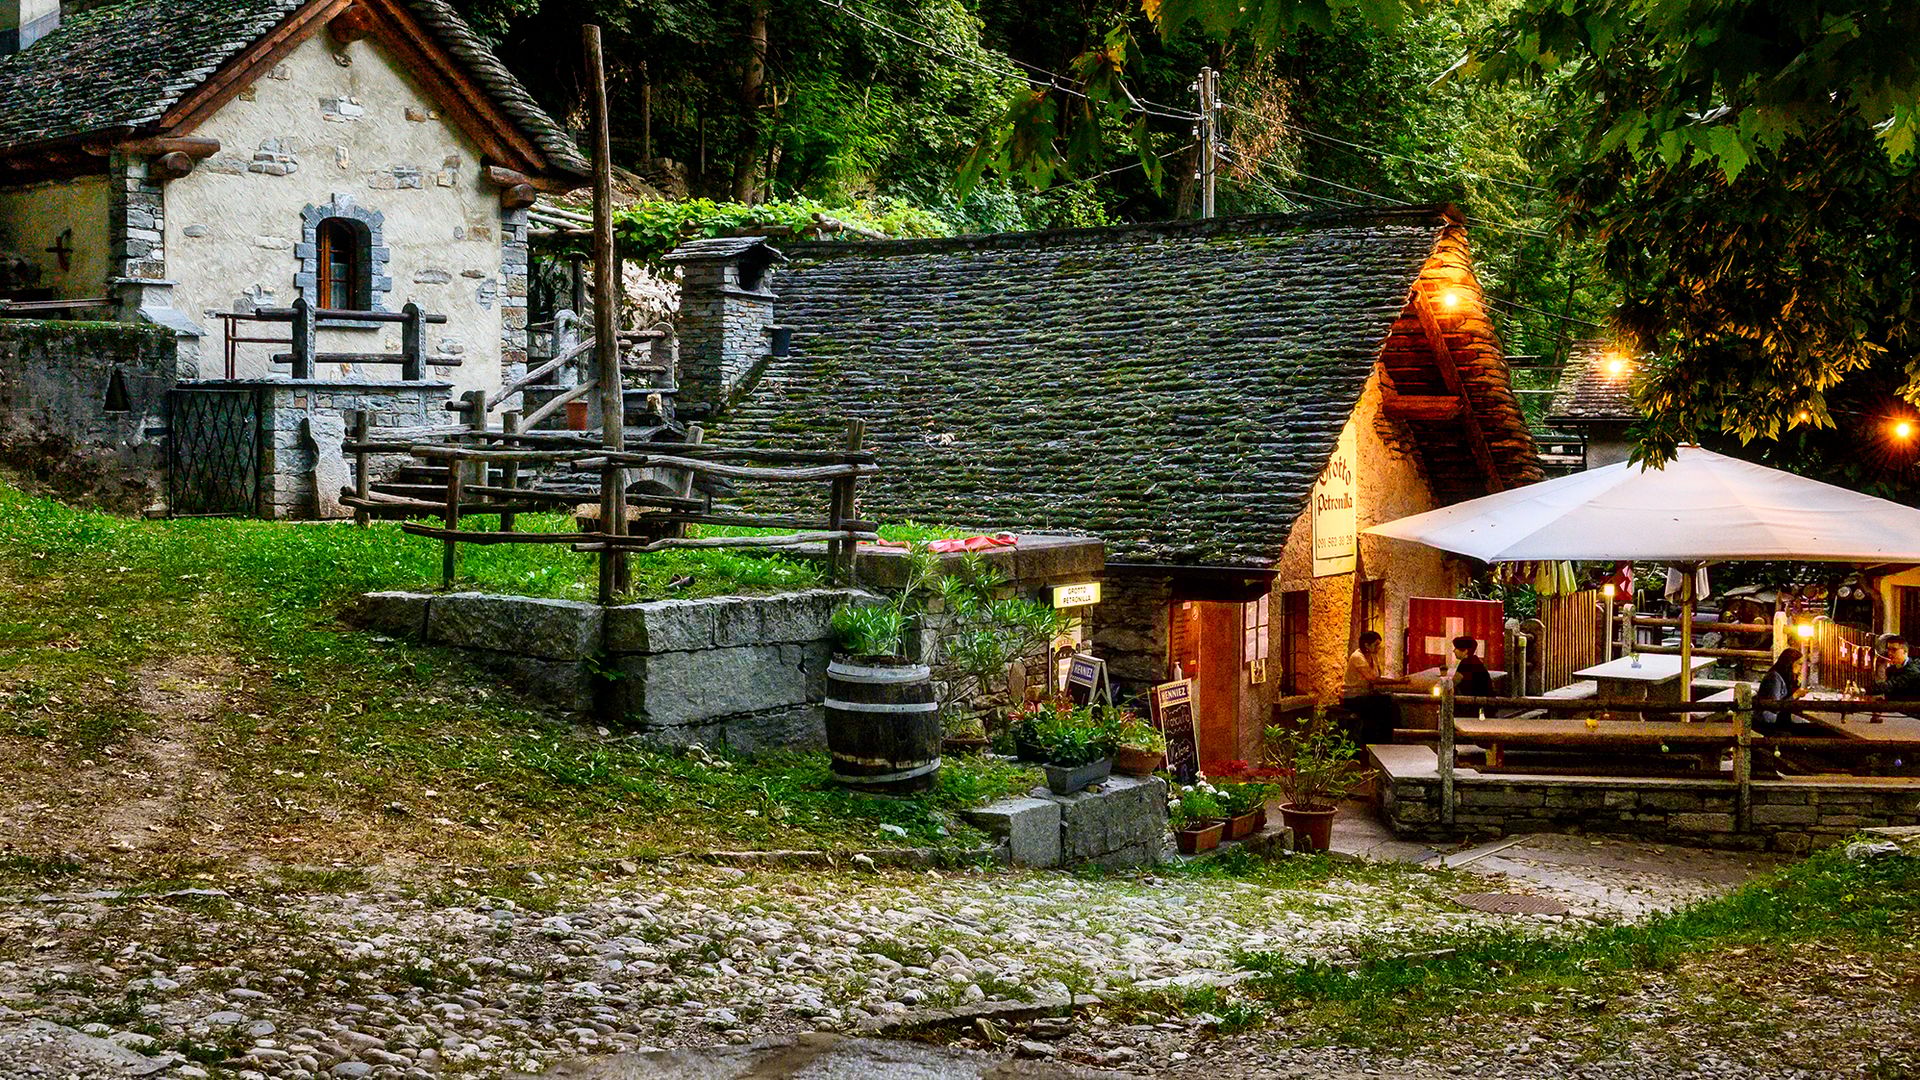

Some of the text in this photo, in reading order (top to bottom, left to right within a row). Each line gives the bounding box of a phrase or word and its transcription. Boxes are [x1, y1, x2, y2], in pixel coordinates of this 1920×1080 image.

[1317, 492, 1353, 516] Petronilla
[1068, 586, 1086, 595] GROTTO
[1063, 595, 1091, 604] PETRONILLA
[1074, 664, 1093, 678] HENNIEZ
[1161, 687, 1186, 701] HENNIEZ
